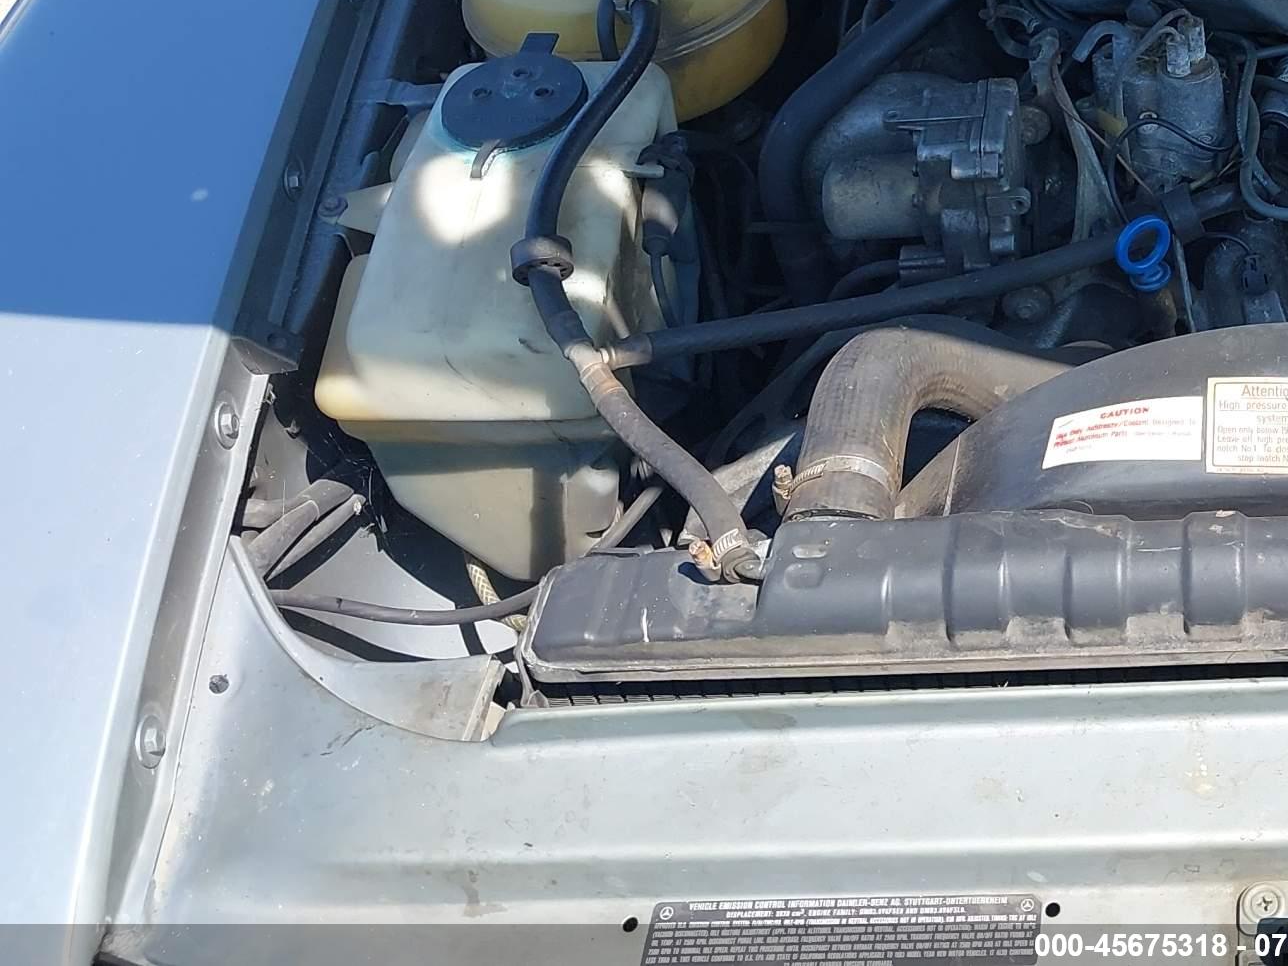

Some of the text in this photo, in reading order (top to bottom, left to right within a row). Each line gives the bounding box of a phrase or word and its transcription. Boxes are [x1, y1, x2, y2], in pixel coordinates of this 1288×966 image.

[1218, 400, 1240, 410] High
[1246, 401, 1287, 411] pressure
[1100, 407, 1150, 419] CAUTION
[689, 902, 718, 911] VEHICLE
[718, 901, 753, 910] EMISSION
[754, 900, 785, 909] CONTROL
[788, 899, 835, 908] INFORMATION
